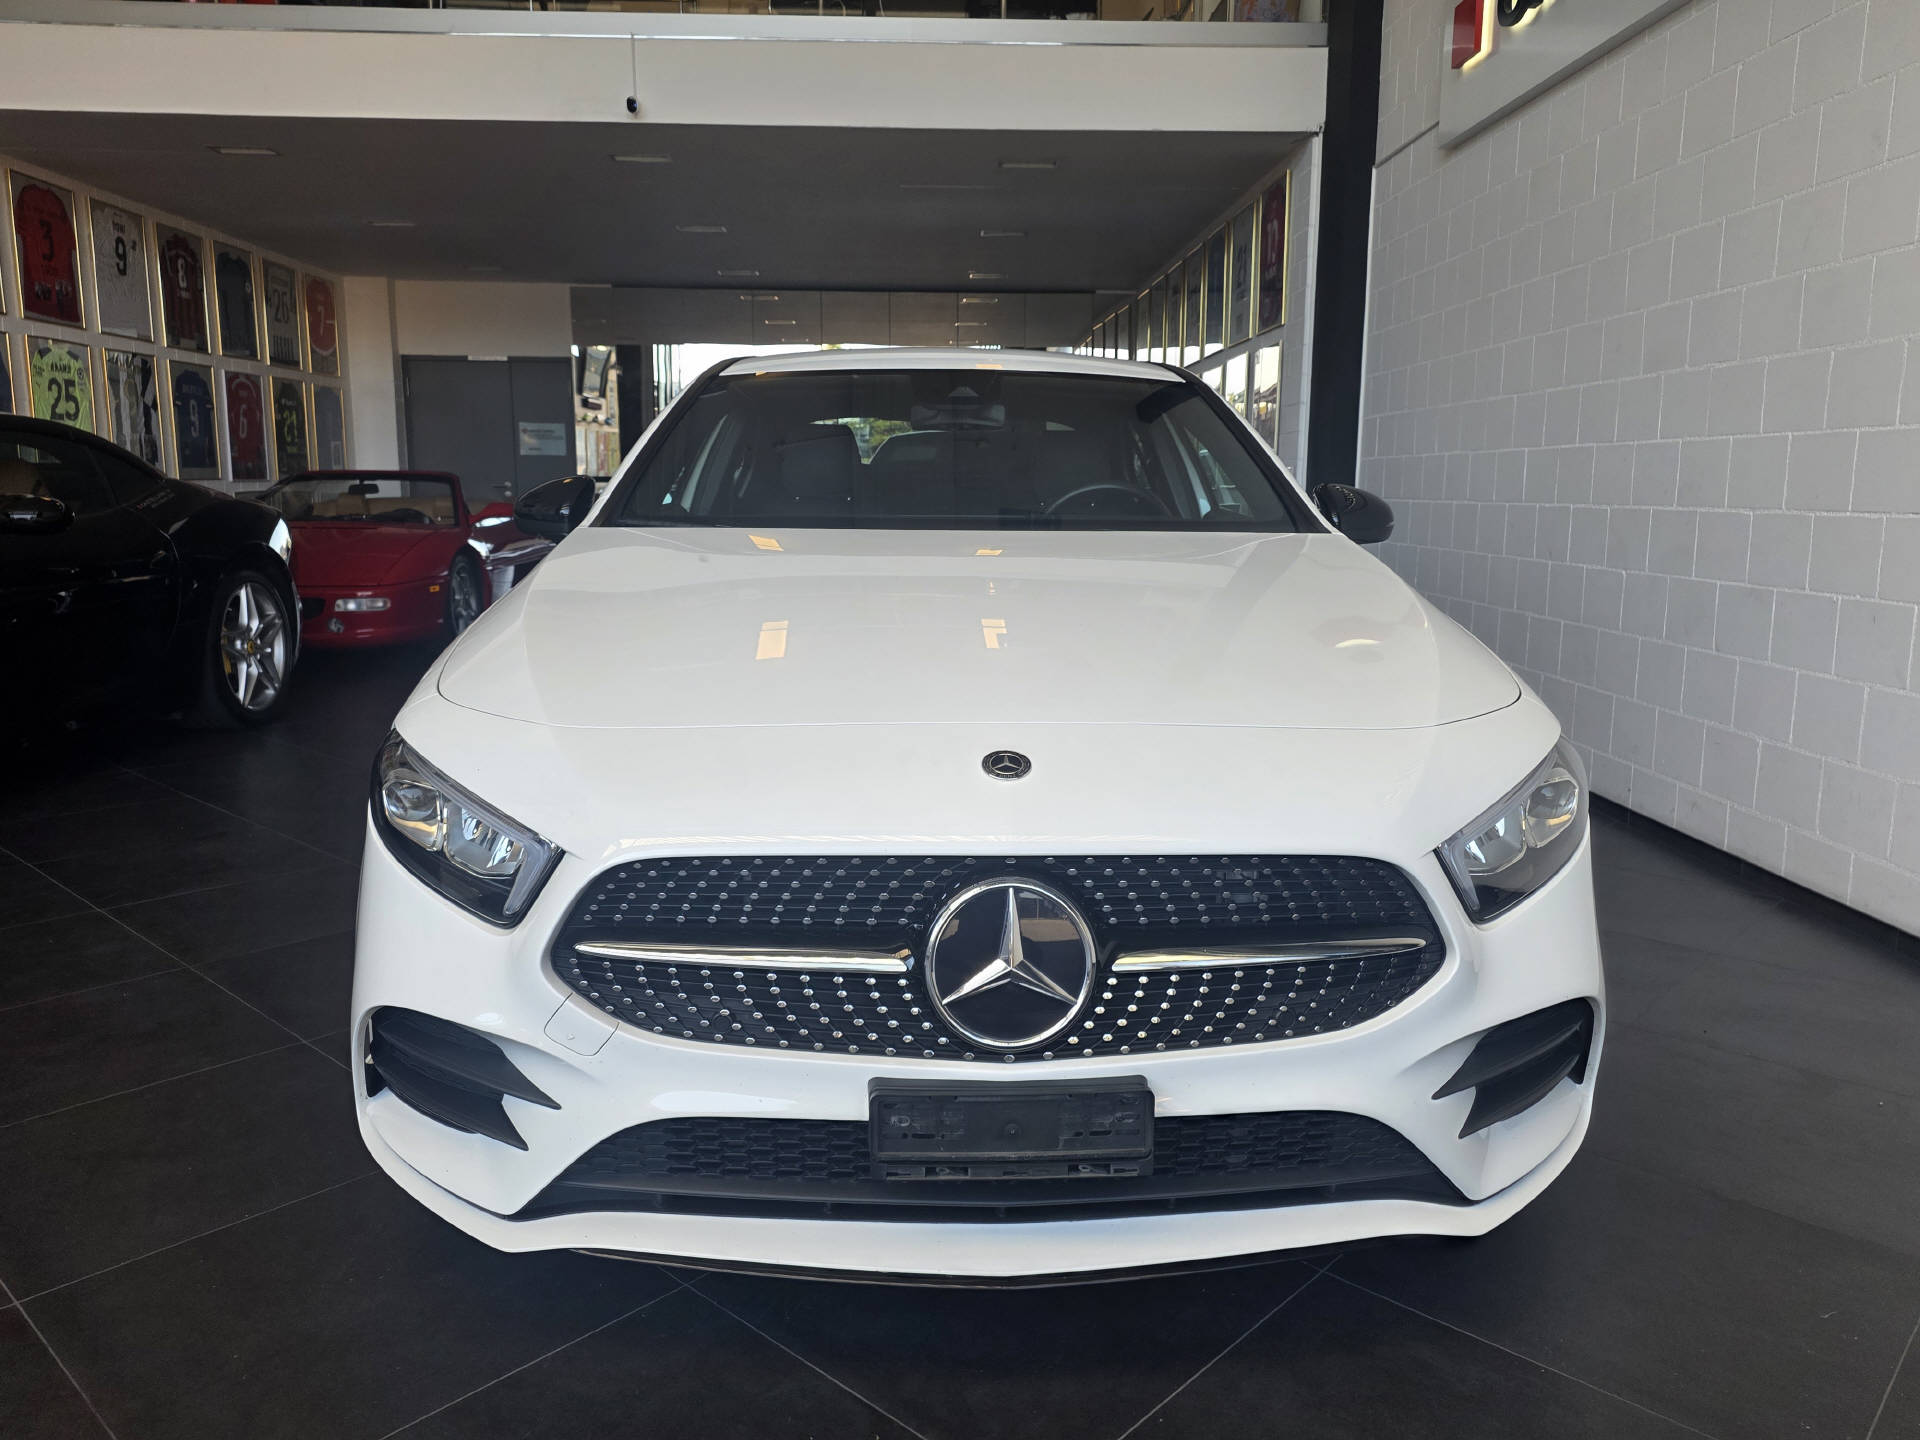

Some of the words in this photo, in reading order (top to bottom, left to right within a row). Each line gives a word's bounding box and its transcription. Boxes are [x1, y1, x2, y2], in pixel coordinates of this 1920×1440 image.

[39, 218, 55, 262] 3
[115, 236, 127, 276] 9
[176, 257, 188, 289] 8
[47, 377, 80, 421] 25
[190, 400, 200, 438] 9
[239, 403, 248, 439] 6
